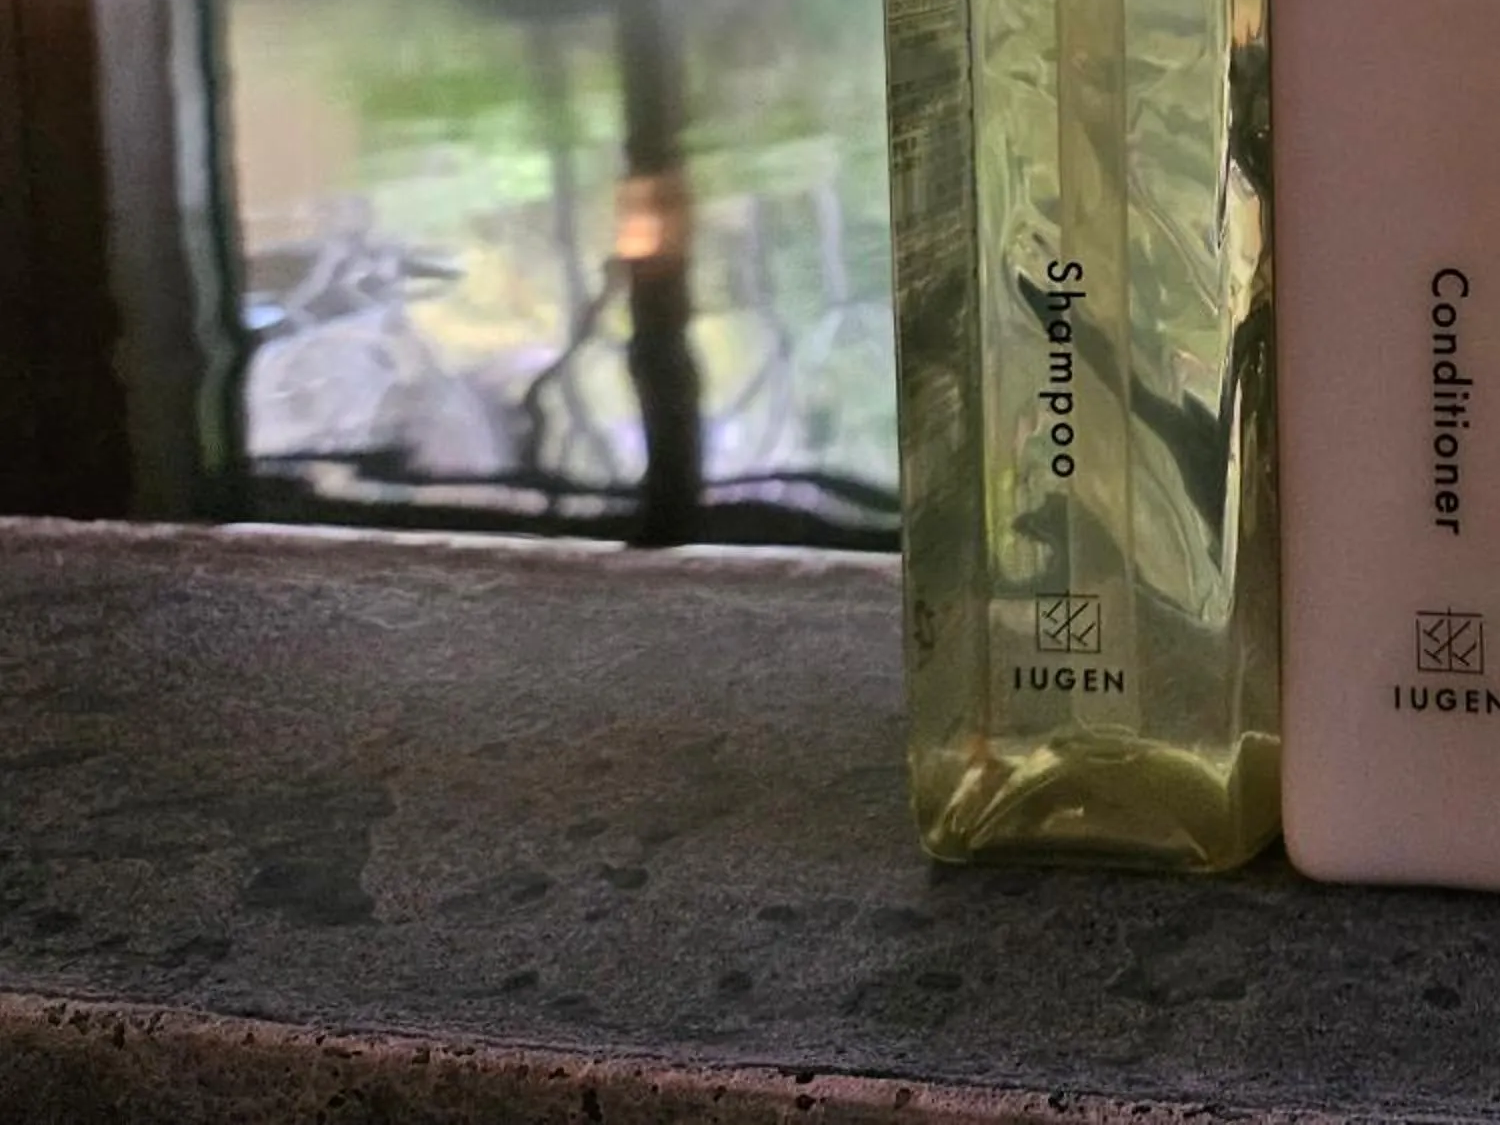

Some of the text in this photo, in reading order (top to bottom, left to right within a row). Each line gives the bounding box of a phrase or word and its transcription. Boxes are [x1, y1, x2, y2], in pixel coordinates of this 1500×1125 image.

[1039, 260, 1086, 477] Shampoo
[1431, 268, 1473, 535] Conditioner
[1014, 666, 1125, 693] IUGEN
